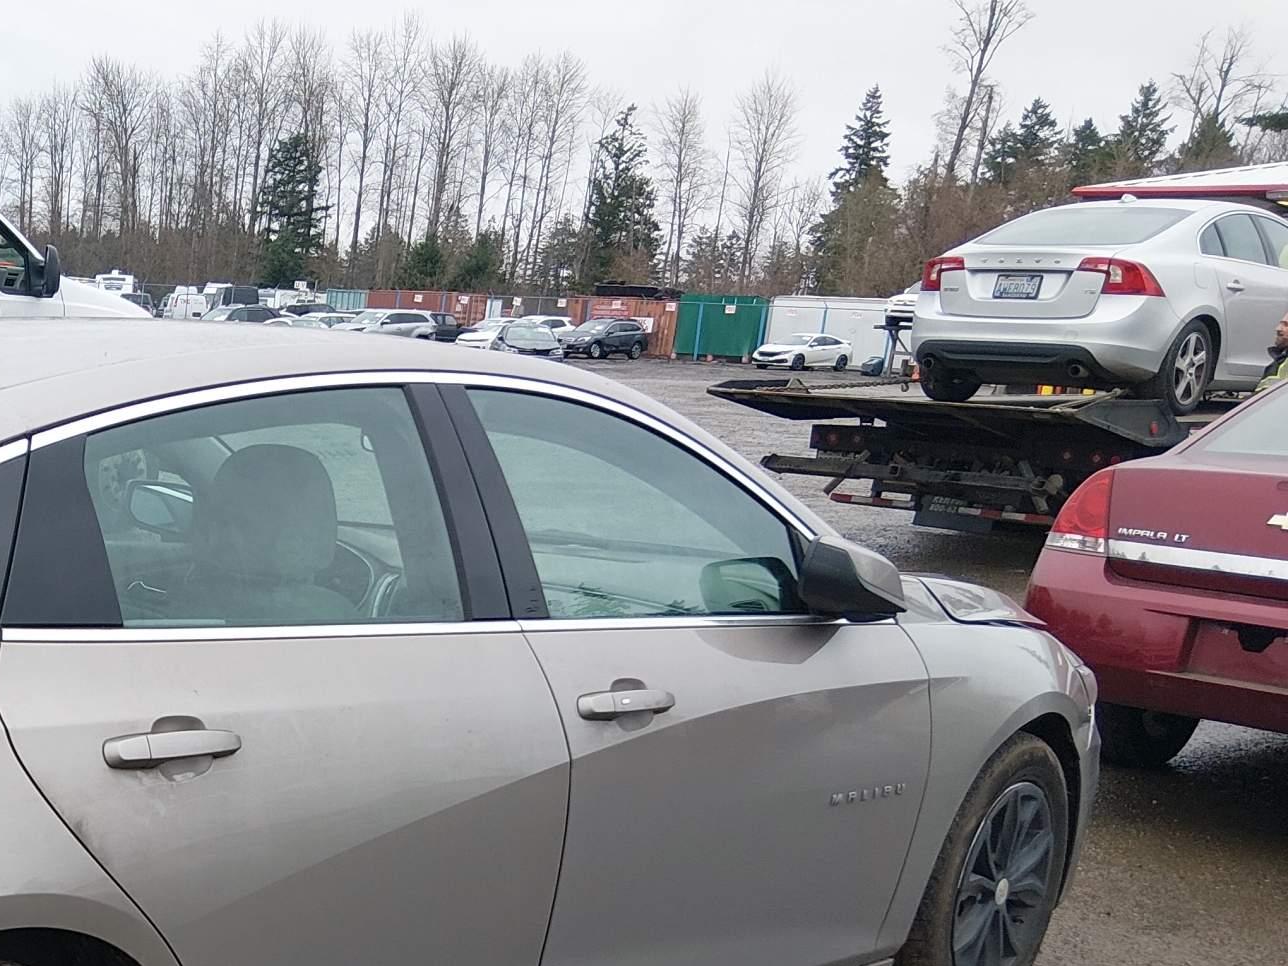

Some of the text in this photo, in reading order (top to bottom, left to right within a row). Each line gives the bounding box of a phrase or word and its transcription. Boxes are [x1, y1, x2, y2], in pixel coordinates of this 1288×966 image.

[1117, 527, 1190, 543] IMPALA LT
[829, 783, 905, 806] MALIBU
